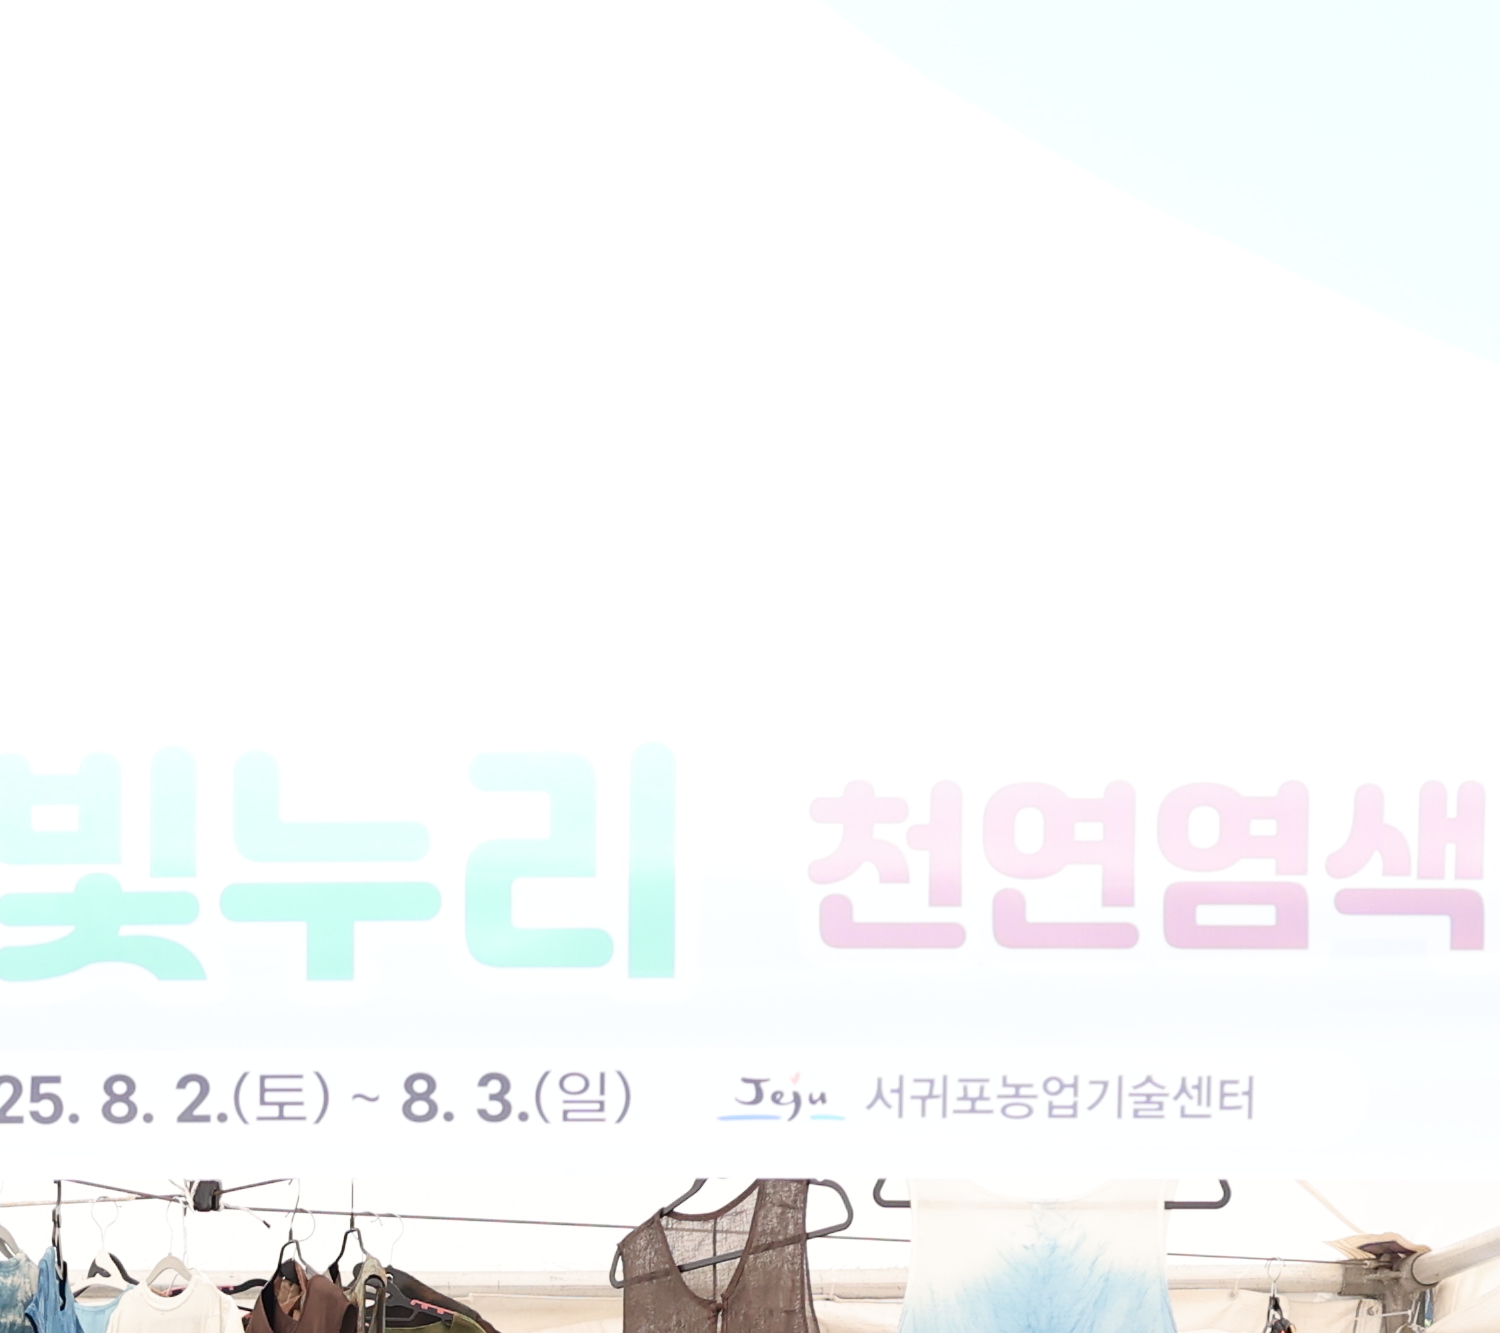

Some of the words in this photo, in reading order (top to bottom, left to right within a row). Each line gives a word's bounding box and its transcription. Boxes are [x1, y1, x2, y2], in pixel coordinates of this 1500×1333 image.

[808, 780, 1487, 951] 천연염색
[100, 1073, 155, 1126] 8.
[175, 1070, 331, 1126] 2.(토)
[401, 1072, 457, 1125] 8.
[476, 1070, 633, 1125] 3.(일)
[732, 1072, 829, 1122] Jeju
[865, 1074, 1256, 1122] 서귀포농업기술센터
